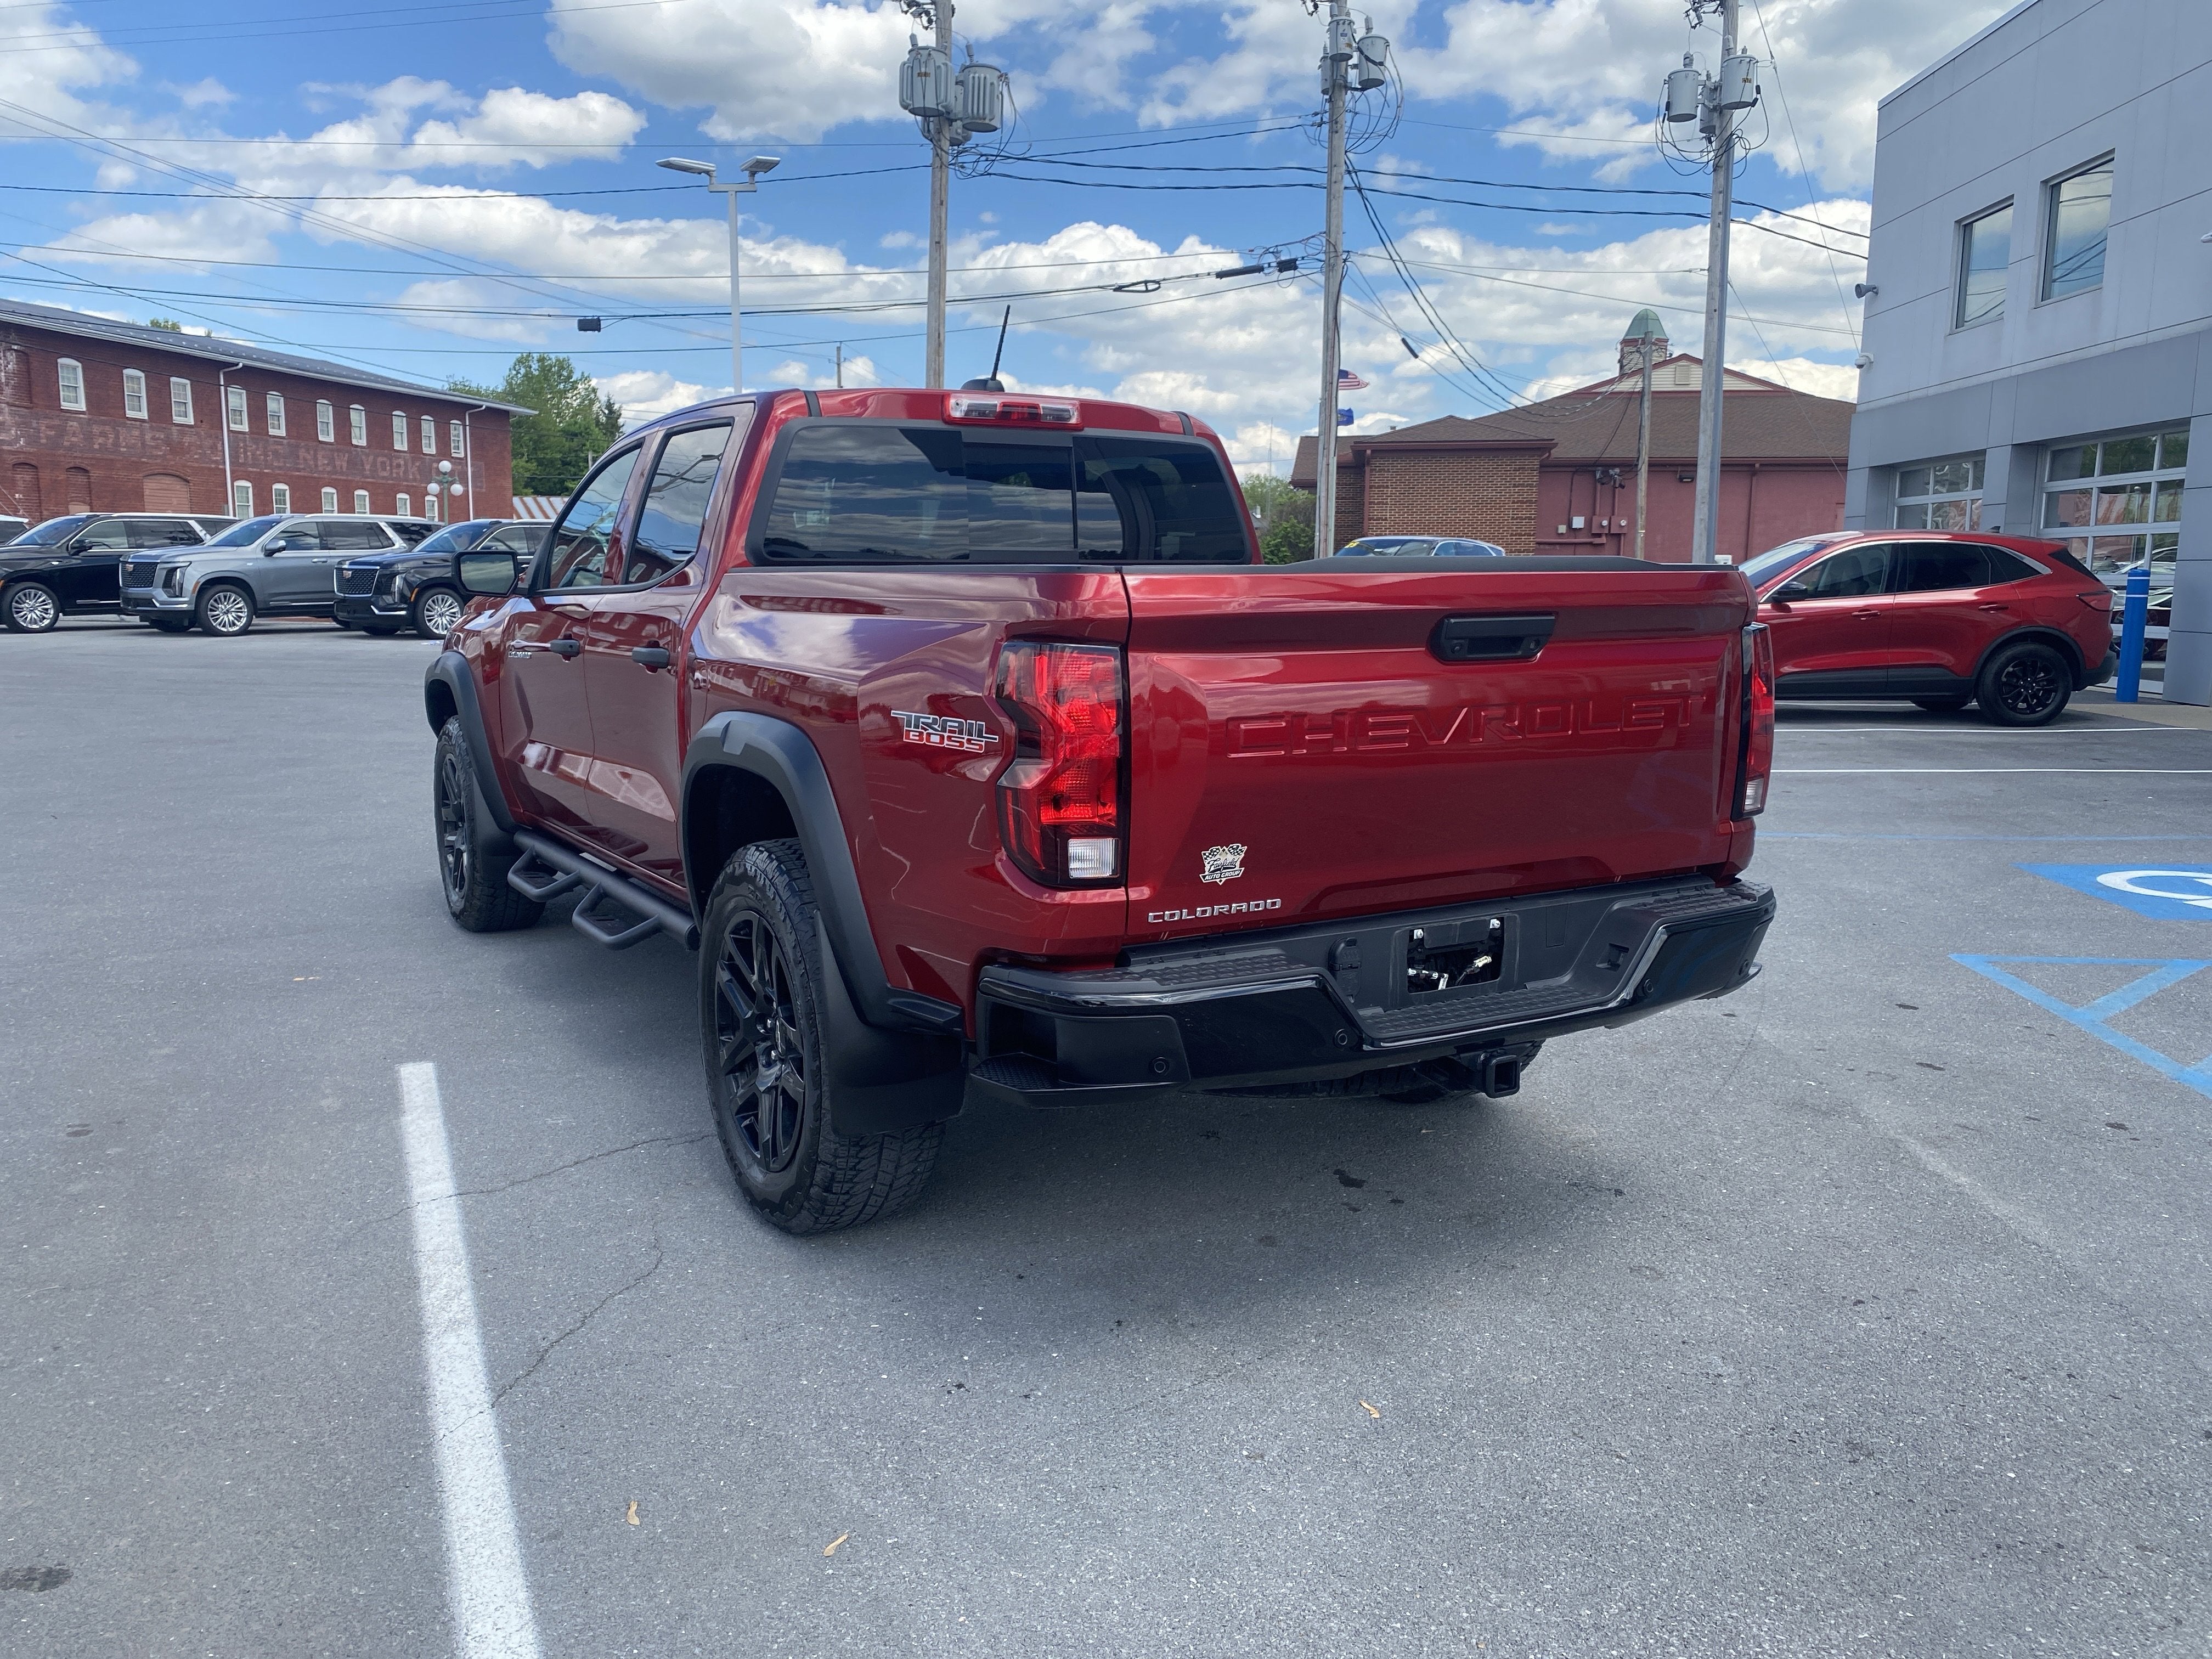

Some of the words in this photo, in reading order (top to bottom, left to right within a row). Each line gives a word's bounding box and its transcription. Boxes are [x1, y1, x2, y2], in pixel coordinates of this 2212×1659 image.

[297, 448, 349, 472] NEW
[362, 455, 420, 479] YORK
[891, 710, 998, 742] TRAIL
[1226, 695, 1706, 758] CHEVROLET
[904, 728, 985, 753] BOSS
[1204, 872, 1220, 881] AUTO
[1221, 870, 1240, 878] GROUP
[1207, 857, 1240, 872] Fairfield
[1148, 898, 1282, 923] COLORADO
